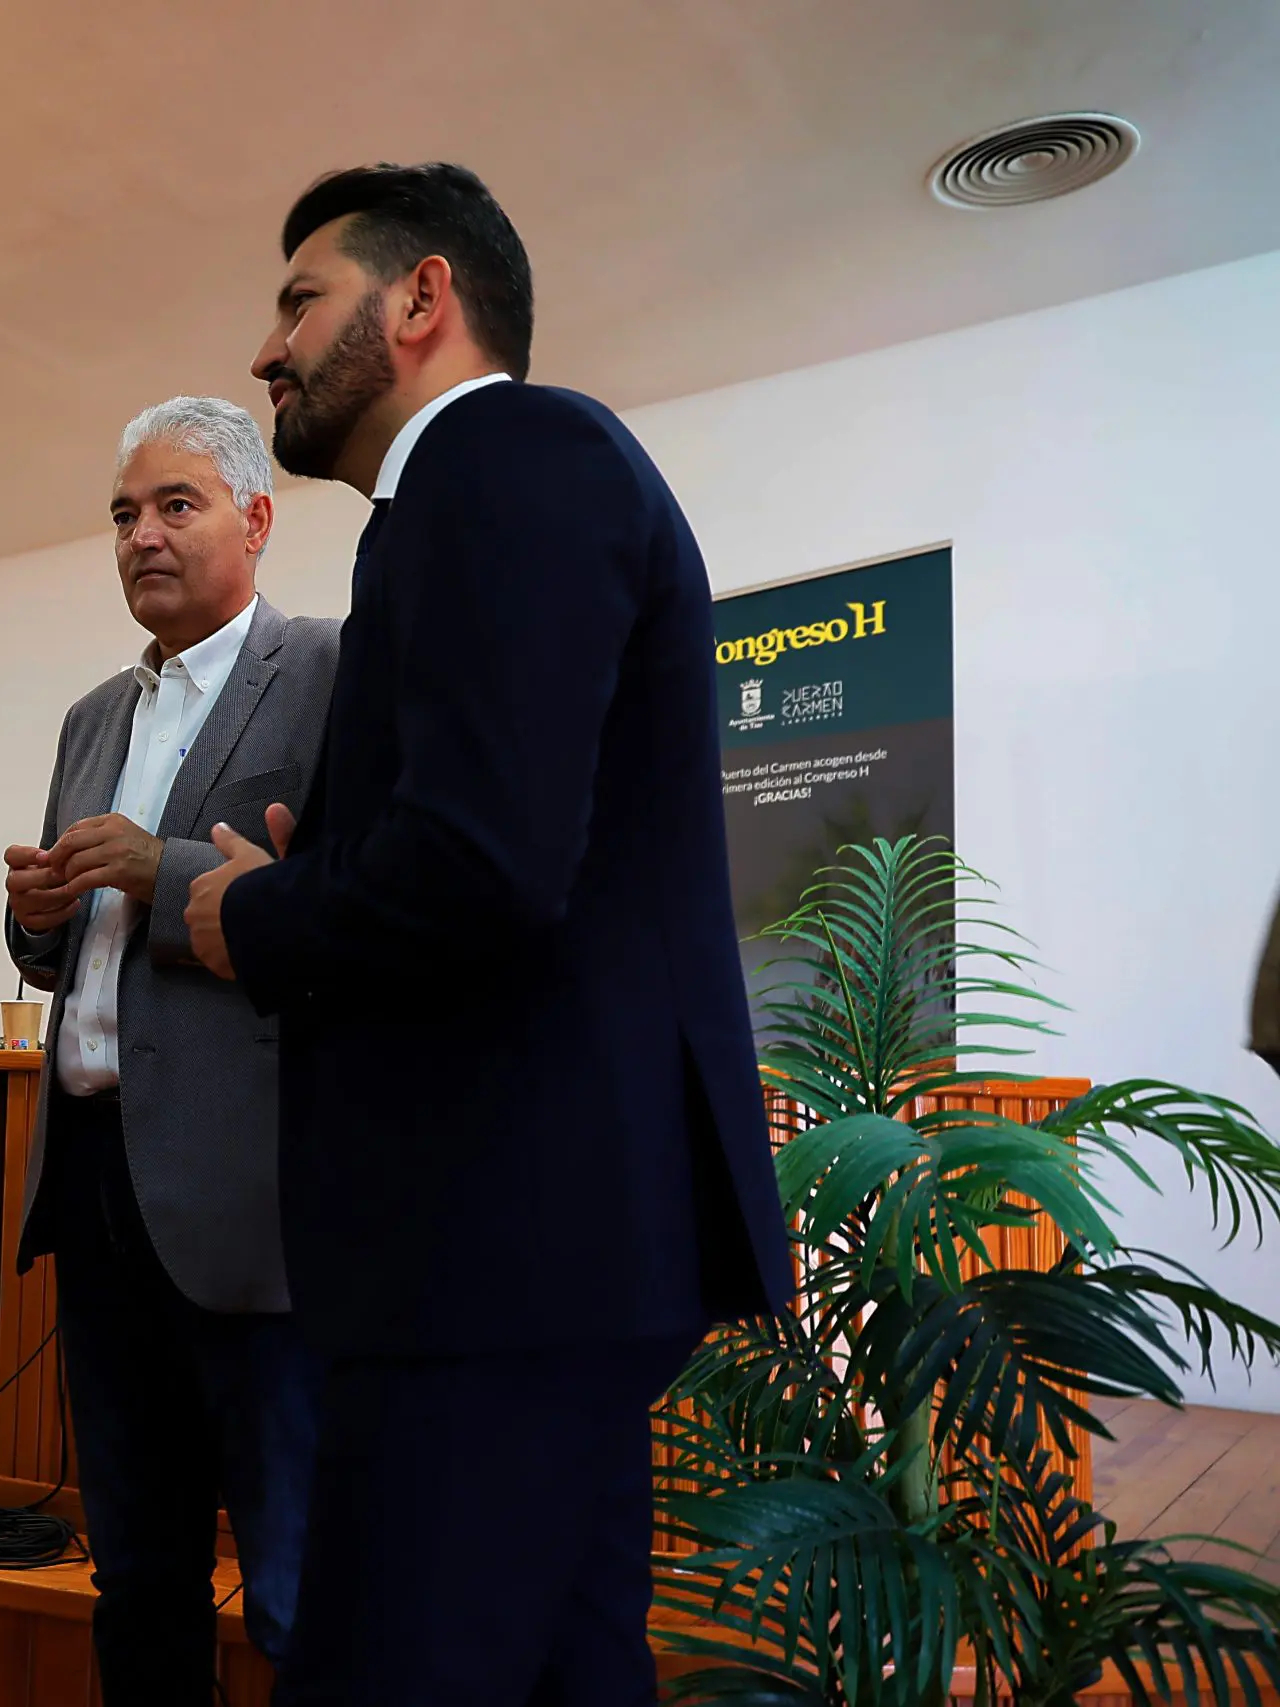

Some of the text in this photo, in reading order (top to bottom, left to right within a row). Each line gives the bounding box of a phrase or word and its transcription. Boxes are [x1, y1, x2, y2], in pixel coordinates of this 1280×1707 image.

[714, 600, 886, 666] ongreso H
[781, 696, 843, 718] CARMEN
[752, 763, 769, 776] del
[770, 760, 812, 774] Carmen
[813, 754, 854, 768] acogen
[854, 748, 888, 762] desde
[722, 765, 870, 795] rimera edición al Congreso H
[753, 787, 812, 807] ¡GRACIAS!
